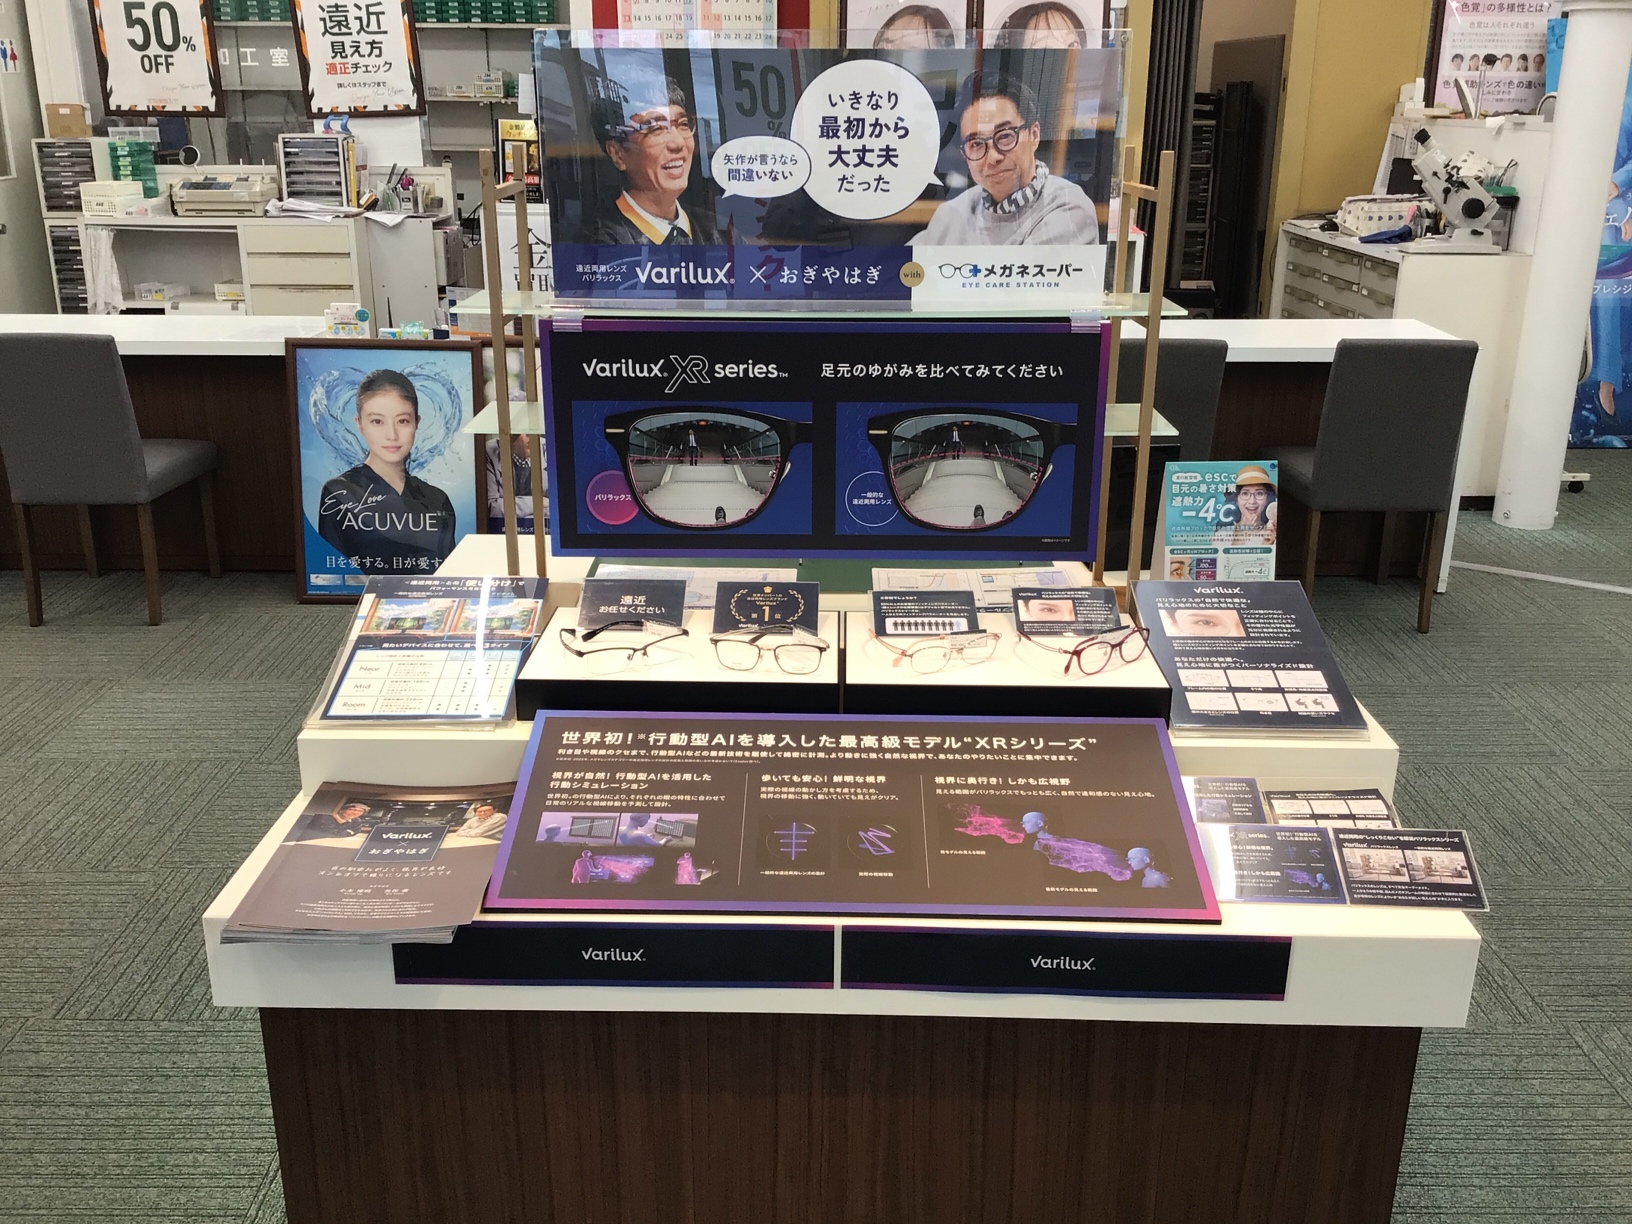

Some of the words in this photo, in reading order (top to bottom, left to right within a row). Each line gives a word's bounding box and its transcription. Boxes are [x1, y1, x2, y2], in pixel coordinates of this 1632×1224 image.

[318, 2, 388, 37] 遠近
[634, 14, 642, 22] 14
[644, 14, 651, 22] 15
[654, 14, 662, 22] 16
[665, 14, 672, 22] 17
[675, 14, 682, 22] 18
[686, 14, 693, 22] 19
[724, 14, 731, 22] 13
[734, 14, 741, 22] 14
[744, 14, 752, 22] 15
[755, 14, 762, 22] 16
[1469, 21, 1535, 29] 色覚は人それぞれ違う
[665, 32, 673, 40] 24
[675, 32, 683, 40] 25
[723, 32, 731, 40] 20
[734, 32, 741, 40] 21
[744, 32, 752, 40] 22
[754, 32, 762, 40] 23
[330, 40, 383, 59] 見え方
[140, 54, 174, 73] OFF
[325, 61, 393, 75] 適正チェック
[337, 81, 387, 89] 詳しくはスタッフまで
[828, 90, 900, 111] いきなり
[818, 116, 910, 140] 最初から
[723, 153, 799, 166] 矢作が言うなら
[828, 144, 900, 168] 大丈夫
[727, 168, 794, 182] 間違いない
[837, 174, 891, 193] だった
[575, 264, 627, 274] 遠近両用レンズ
[779, 265, 882, 285] おぎやはぎ
[903, 270, 922, 280] with
[983, 263, 1083, 278] メガネスーパー
[581, 273, 622, 283] バリラックス
[962, 281, 981, 289] EYE
[665, 355, 711, 393] XR
[820, 363, 1064, 378] 足元のゆがみを比べてみてください
[1171, 484, 1237, 493] 目元の暑さ対策
[321, 490, 355, 520] Eye
[355, 484, 387, 513] Love
[852, 498, 892, 506] 遠近両用レンズ
[1171, 496, 1204, 507] 遮熱力
[342, 512, 439, 531] ACUVUE
[620, 595, 646, 605] 遠近
[598, 606, 665, 614] お任せください
[359, 665, 381, 673] Near
[549, 781, 648, 790] 行動シミュレーション
[368, 847, 430, 855] おぎやはぎ
[581, 947, 644, 963] Varilux
[1030, 954, 1094, 971] Varilux
